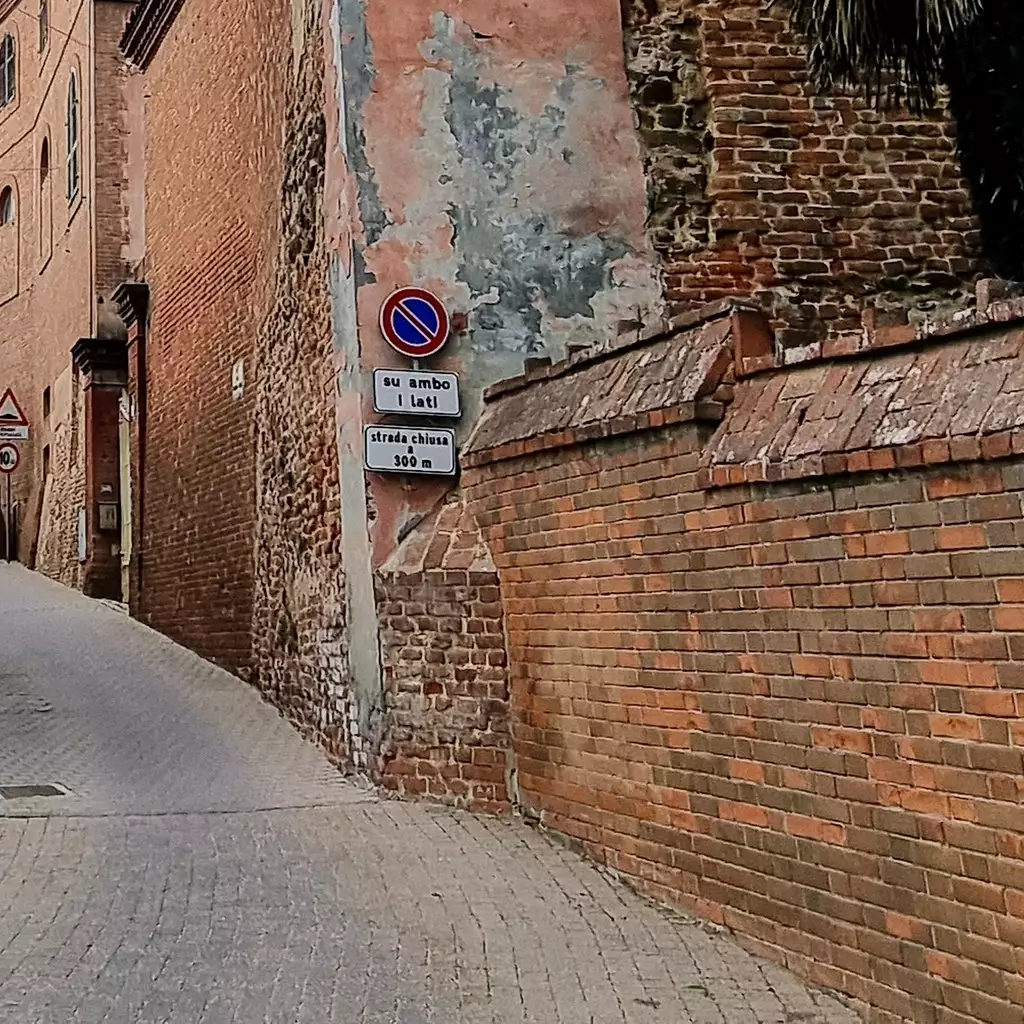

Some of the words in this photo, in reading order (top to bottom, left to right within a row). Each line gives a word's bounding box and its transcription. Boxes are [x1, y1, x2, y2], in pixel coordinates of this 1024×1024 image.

[383, 377, 400, 387] su
[409, 377, 450, 390] ambo
[411, 394, 438, 408] lati
[371, 431, 407, 443] strada
[411, 433, 449, 445] chiusa
[407, 445, 414, 454] a
[394, 454, 417, 467] 300
[421, 459, 432, 468] m
